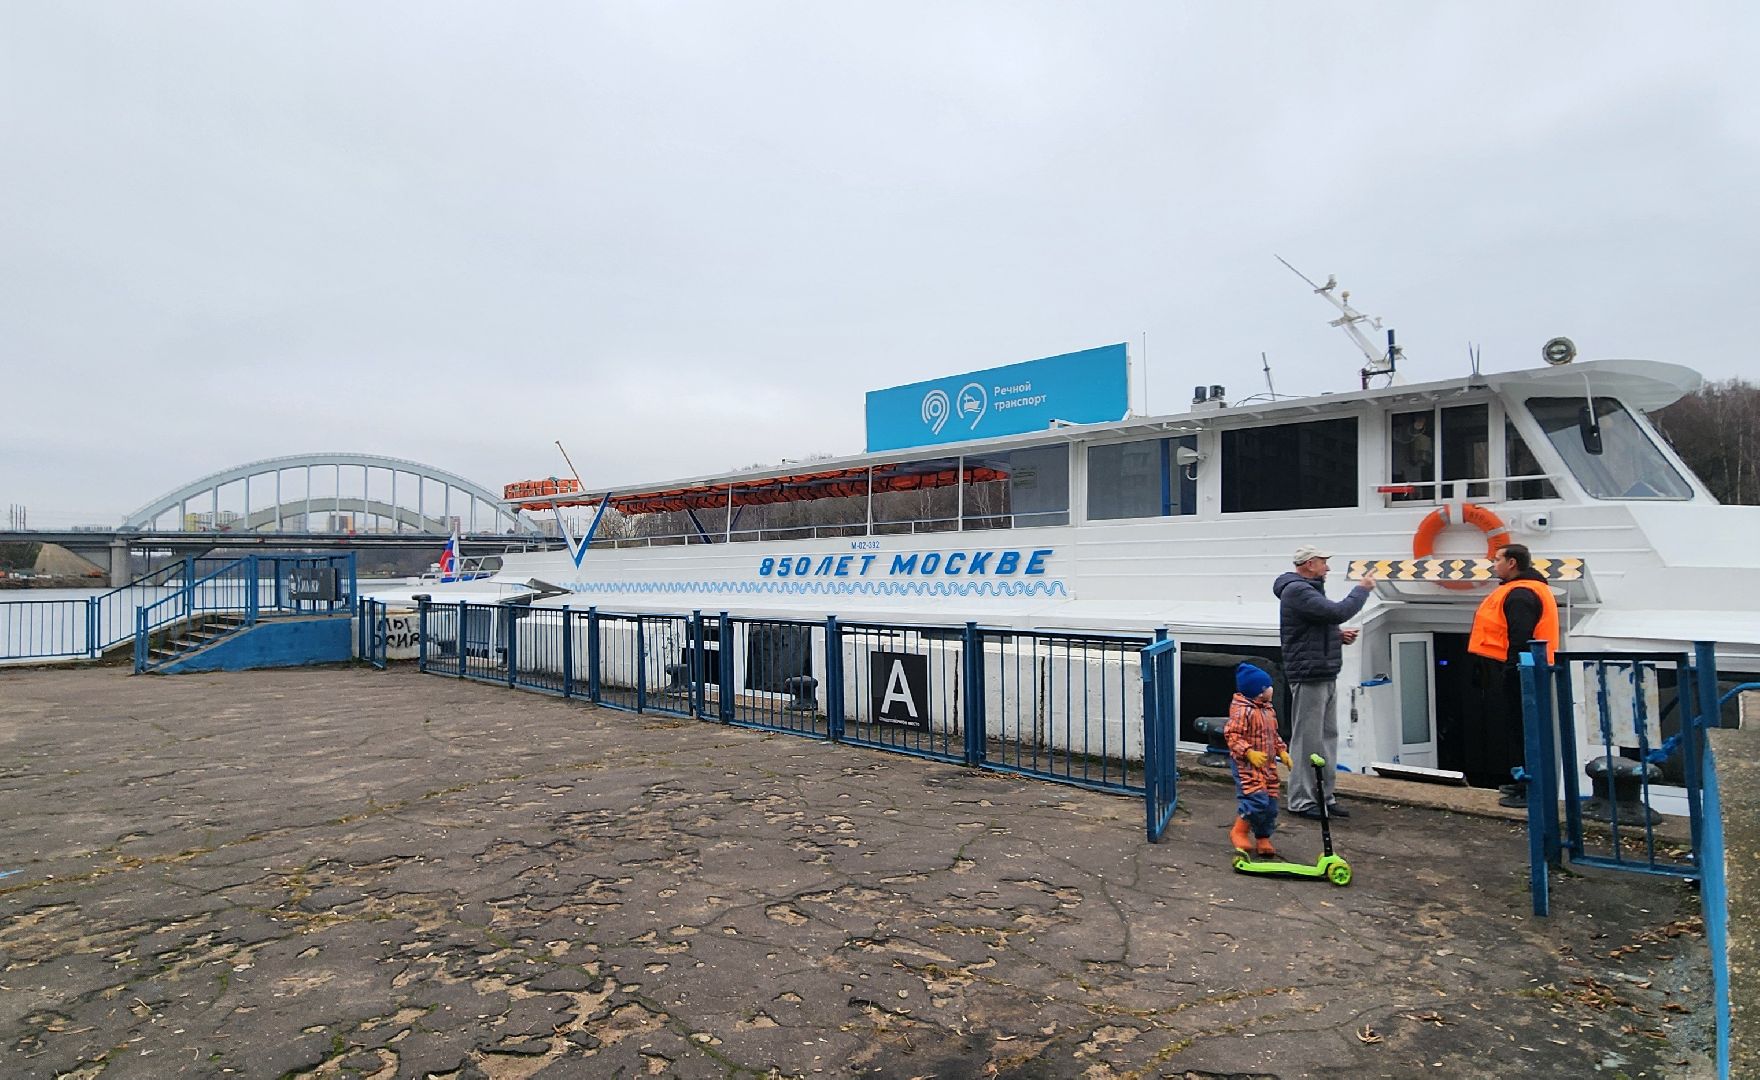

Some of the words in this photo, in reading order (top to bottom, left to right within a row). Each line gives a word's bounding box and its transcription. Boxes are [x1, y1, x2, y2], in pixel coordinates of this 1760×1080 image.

[994, 382, 1031, 397] Речной
[994, 394, 1046, 411] транспорт
[889, 549, 1053, 576] МОСКВЕ
[880, 659, 918, 717] А
